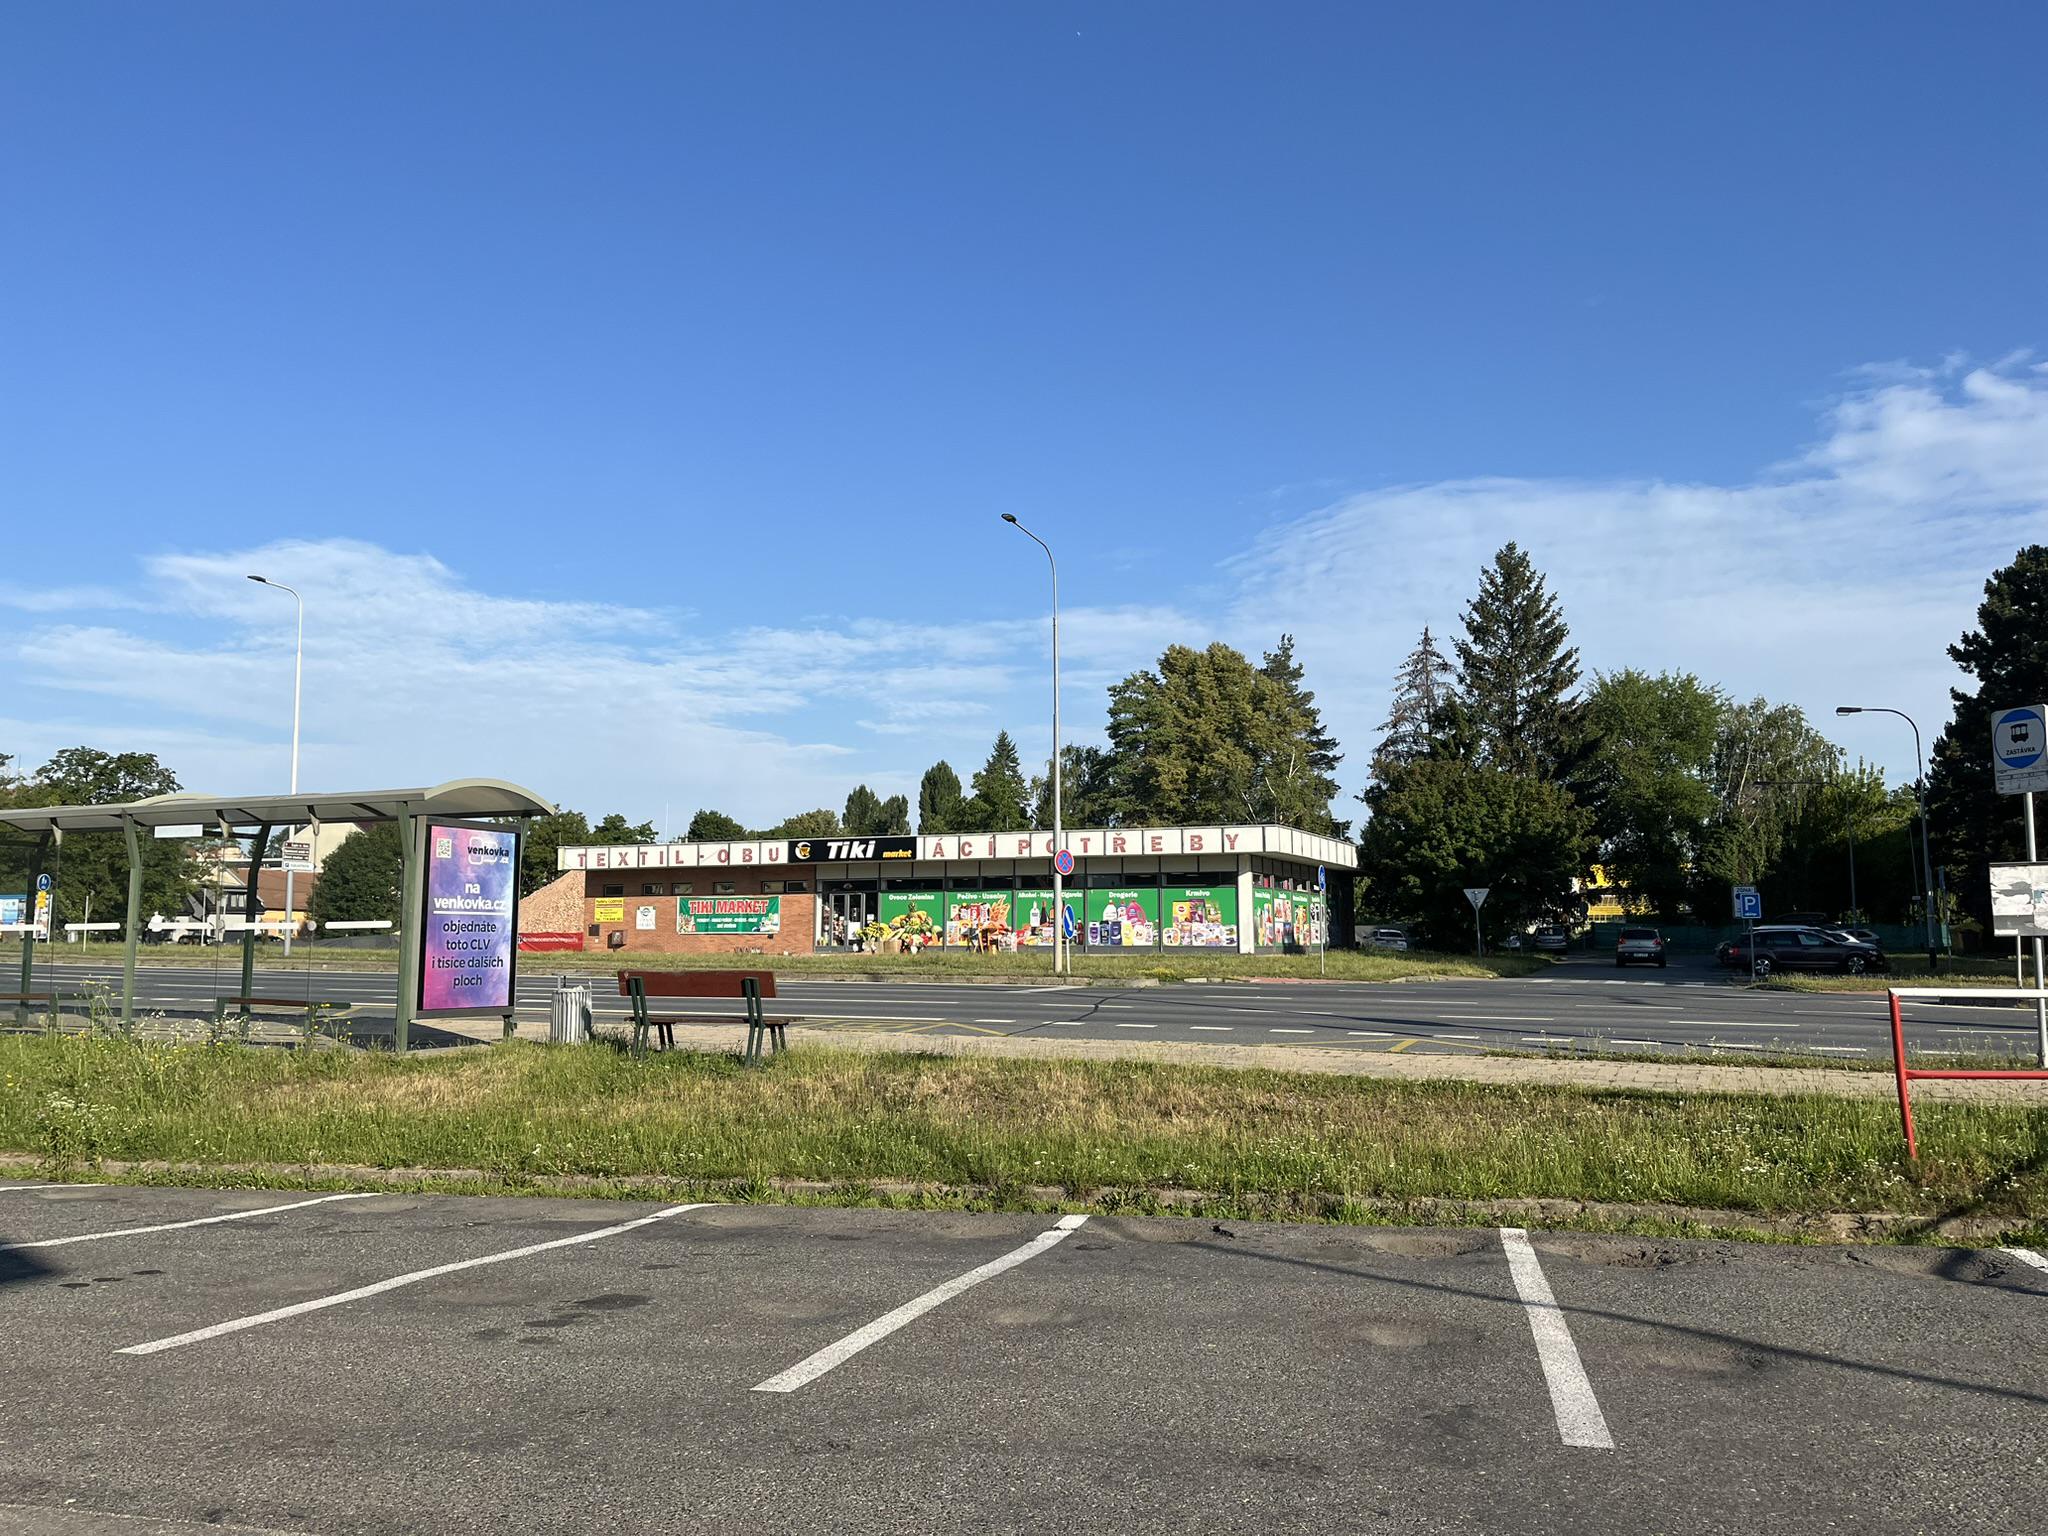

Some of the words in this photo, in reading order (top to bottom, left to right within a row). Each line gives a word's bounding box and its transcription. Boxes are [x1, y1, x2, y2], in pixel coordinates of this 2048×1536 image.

[2006, 746, 2036, 756] ZASTÁVKA
[467, 846, 509, 857] venkovka
[826, 840, 876, 859] Tiki
[882, 849, 912, 858] market
[465, 883, 480, 894] na
[1108, 891, 1138, 899] Drogerie
[433, 896, 506, 910] venkovka.cz
[715, 899, 769, 914] MARKET
[1744, 896, 1756, 911] P
[443, 921, 497, 935] objednáte
[446, 940, 469, 951] toto
[470, 939, 491, 950] CLV
[437, 956, 466, 968] tisíce
[468, 956, 504, 968] dalších
[453, 974, 483, 989] ploch
